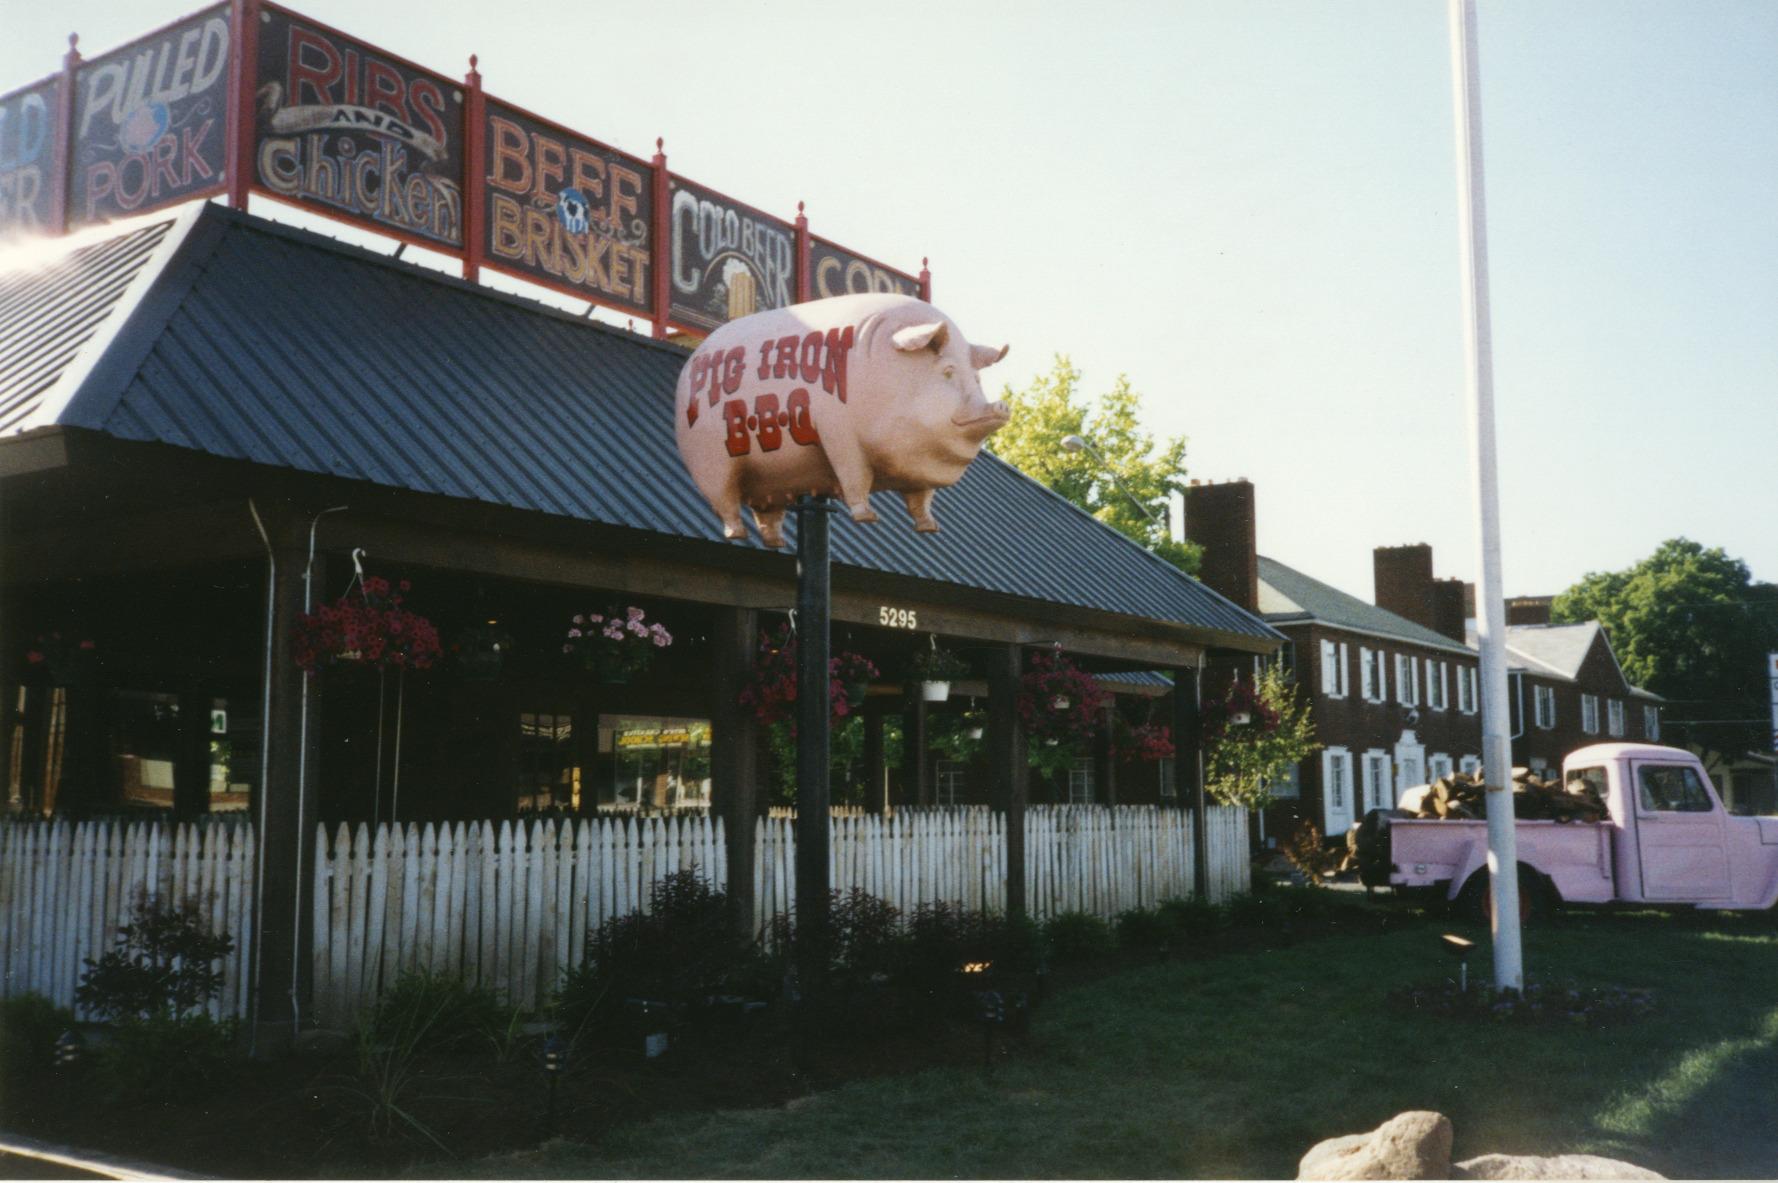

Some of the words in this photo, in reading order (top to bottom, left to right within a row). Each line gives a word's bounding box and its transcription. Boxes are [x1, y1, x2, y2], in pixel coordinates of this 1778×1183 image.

[81, 19, 228, 137] PULLED
[288, 24, 446, 147] RIBS
[333, 108, 414, 140] AND
[87, 119, 214, 219] PORK
[258, 134, 461, 243] Chicken
[487, 116, 643, 230] BEEF
[492, 194, 650, 304] BRISKET
[672, 190, 740, 293] COLD
[741, 218, 794, 309] BEER
[816, 256, 903, 297] CO
[686, 346, 747, 428] PIG
[757, 326, 854, 404] IRON
[879, 606, 917, 630] 5295
